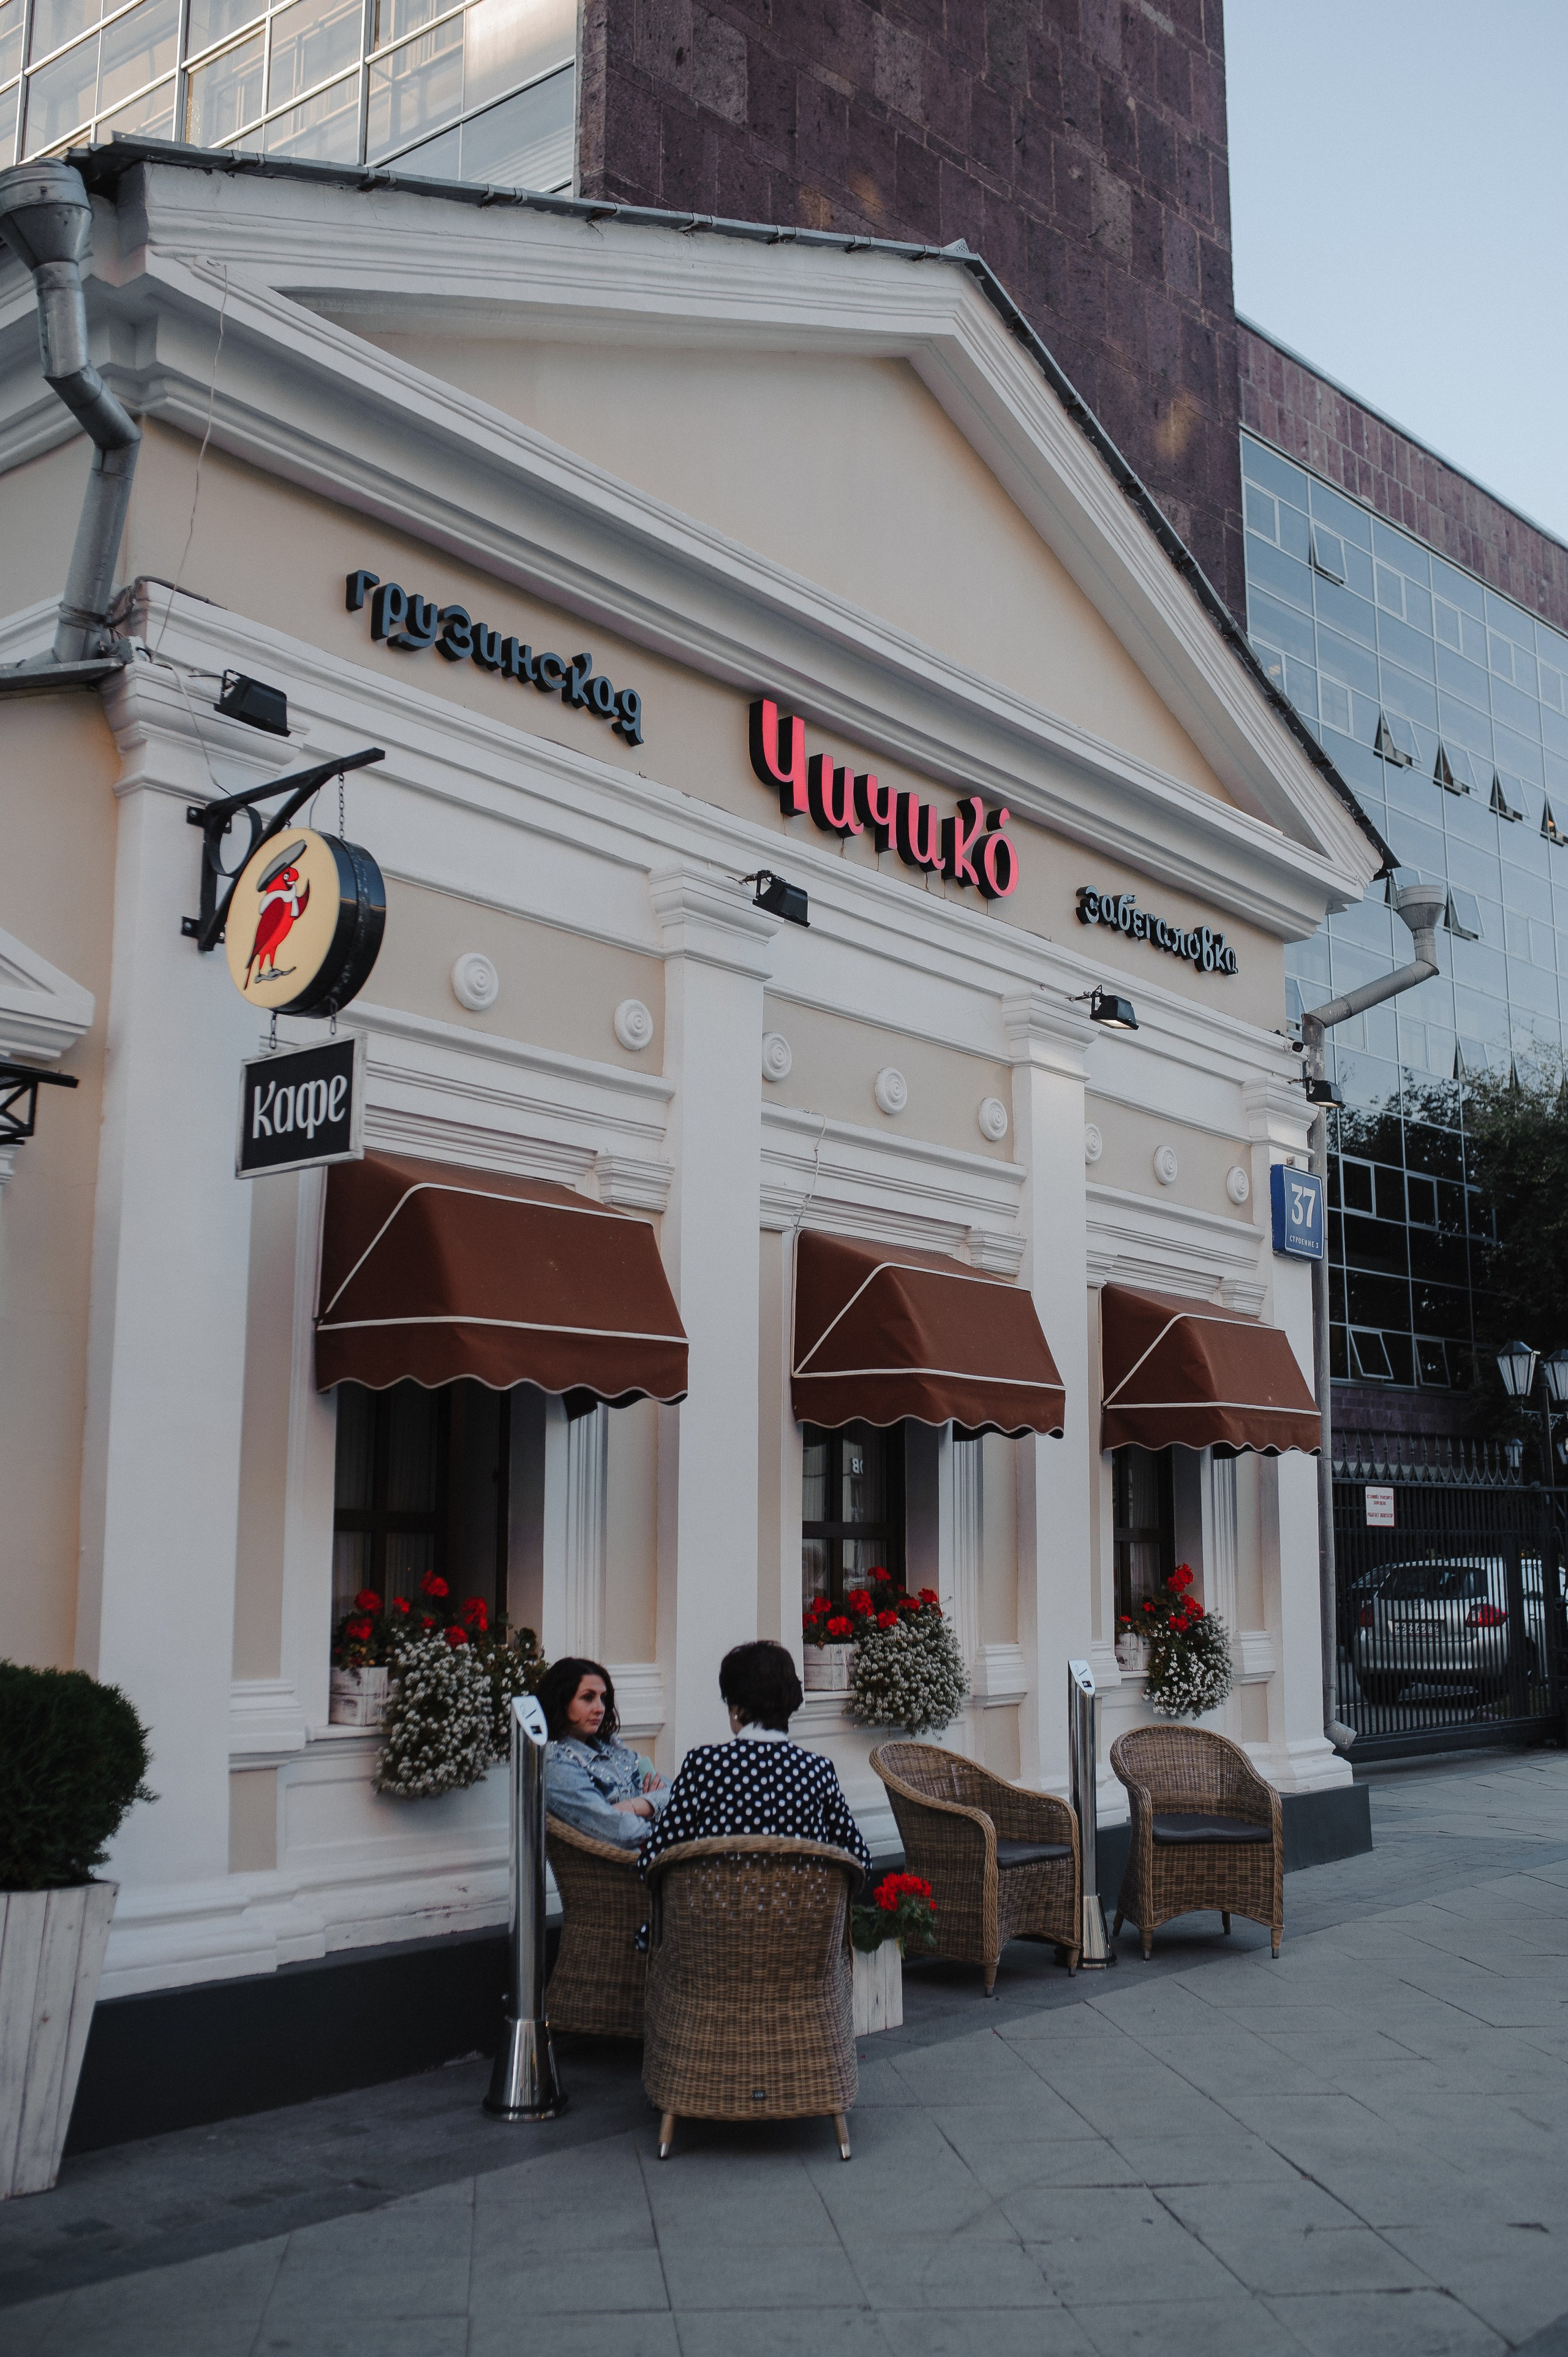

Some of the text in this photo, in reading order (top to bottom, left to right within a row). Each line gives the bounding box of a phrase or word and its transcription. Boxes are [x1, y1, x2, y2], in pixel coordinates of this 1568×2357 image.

[346, 570, 644, 746] грузинская
[1076, 885, 1238, 975] забегаловка
[1291, 1182, 1316, 1228] 37
[1289, 1235, 1314, 1248] СТРОЕНИЕ
